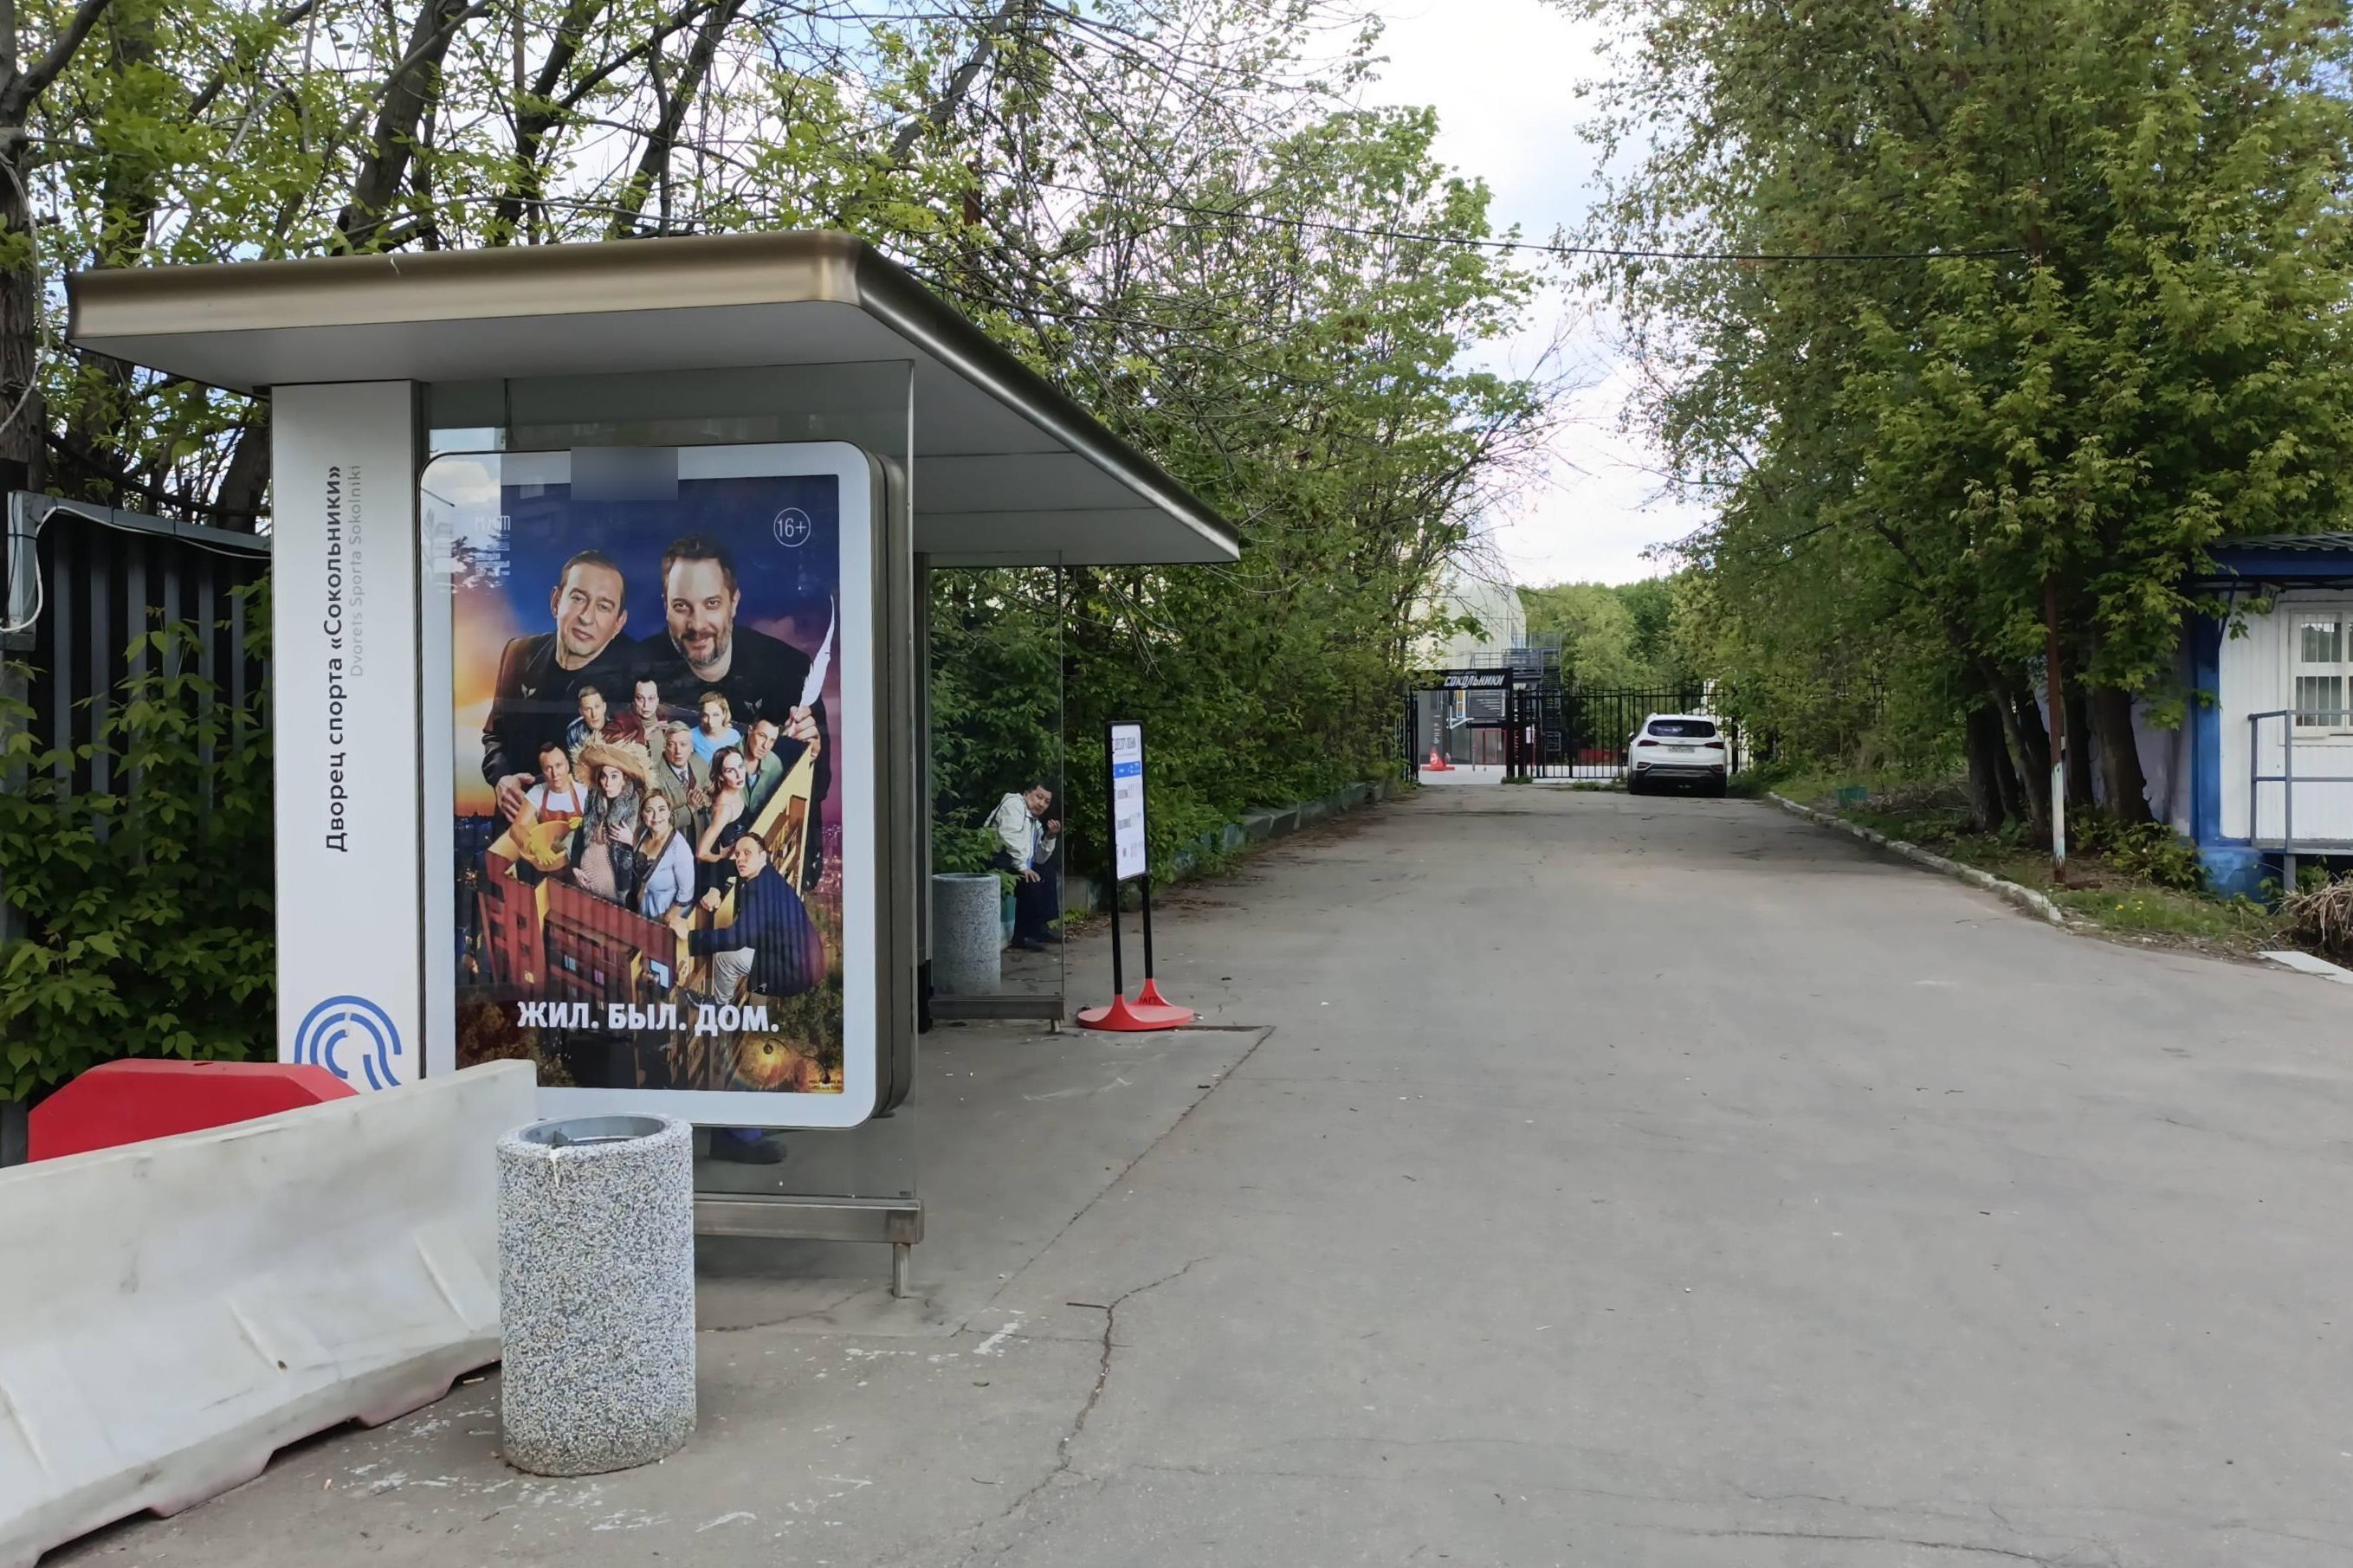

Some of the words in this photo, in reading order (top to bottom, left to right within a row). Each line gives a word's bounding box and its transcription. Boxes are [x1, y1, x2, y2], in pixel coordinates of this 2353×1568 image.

[347, 465, 362, 545] Sokolniki
[777, 518, 807, 538] 16+
[324, 466, 342, 649] «Сокольники»
[349, 552, 365, 606] Sporta
[349, 611, 364, 677] Dvorets
[329, 658, 348, 745] спорта
[1444, 674, 1505, 688] СОКОЛЬНИКИ
[326, 752, 348, 852] Дворец
[517, 1001, 599, 1029] ЖИЛ.
[608, 1003, 687, 1031] БЫЛ.
[695, 1003, 779, 1037] ДОМ.
